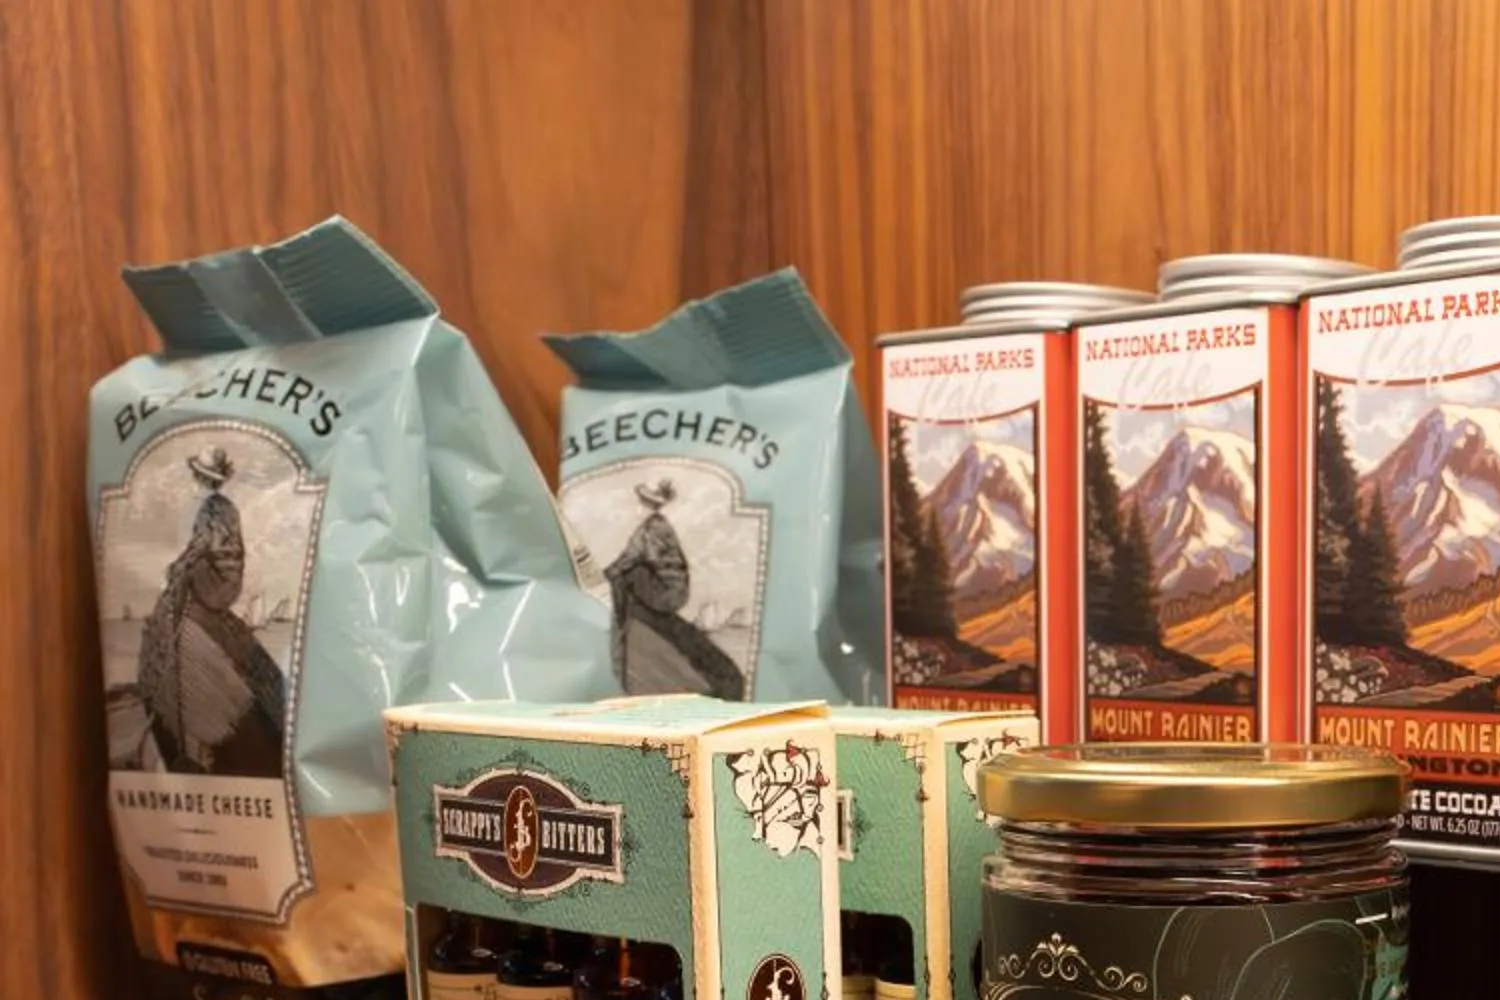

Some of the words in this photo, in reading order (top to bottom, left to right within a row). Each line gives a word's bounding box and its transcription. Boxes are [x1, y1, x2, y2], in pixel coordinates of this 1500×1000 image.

[1318, 297, 1435, 333] NATIONAL
[1085, 331, 1180, 361] NATIONAL
[1187, 324, 1257, 350] PARKS
[889, 353, 970, 379] NATIONAL
[975, 348, 1035, 371] PARKS
[113, 367, 342, 442] BEHER'S
[1091, 708, 1154, 736] MOUNT
[1162, 710, 1252, 743] RAINIER
[1320, 716, 1395, 747] MOUNT
[117, 787, 205, 816] HANDMADE
[212, 793, 274, 820] CHEESE
[443, 807, 501, 842] SCRAPPY'S
[541, 820, 606, 856] BITTERS
[1411, 815, 1430, 831] NET
[1430, 816, 1446, 832] WT.
[1447, 817, 1467, 834] 6.25
[1467, 819, 1480, 835] OZ
